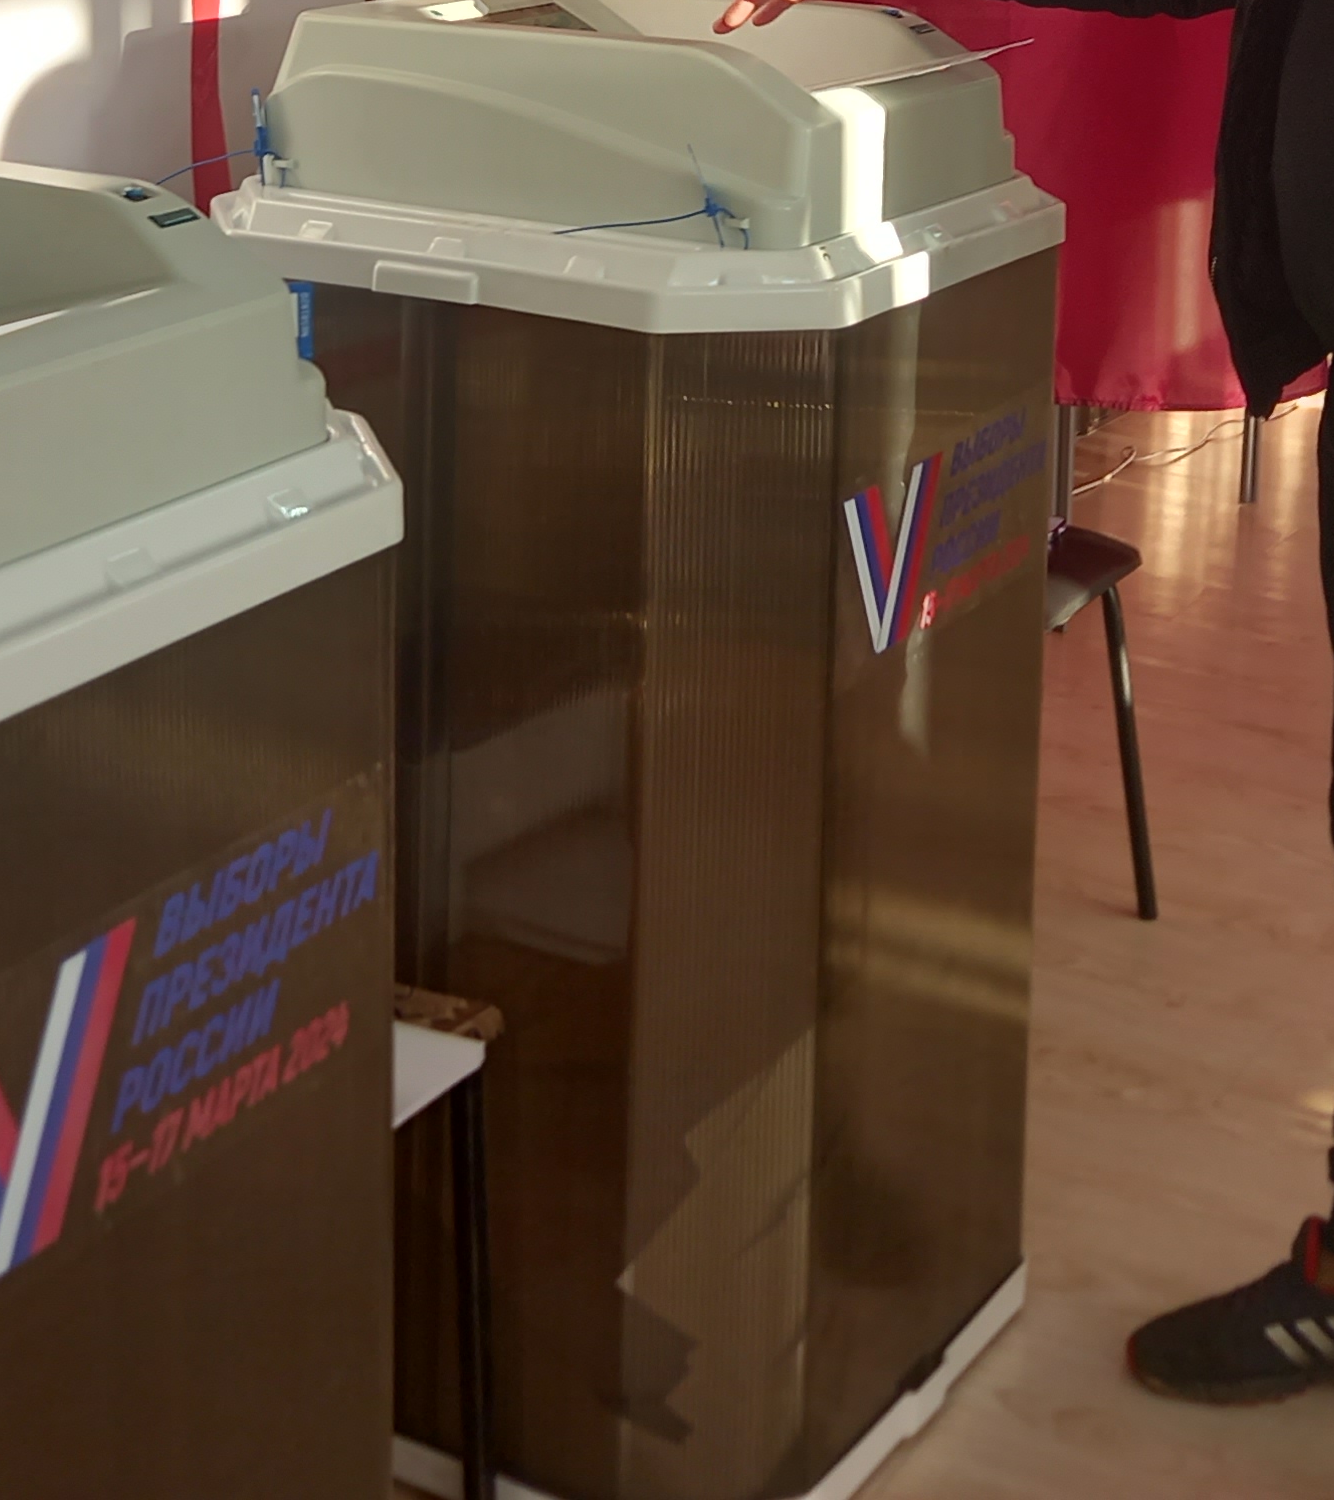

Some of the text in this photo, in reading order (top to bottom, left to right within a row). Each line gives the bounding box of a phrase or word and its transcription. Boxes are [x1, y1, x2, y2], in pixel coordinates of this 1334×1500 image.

[131, 850, 380, 1047] ПРЕЗИДЕНТА
[153, 807, 333, 959] ВЫБОРЫ
[110, 978, 281, 1135] РОССИИ
